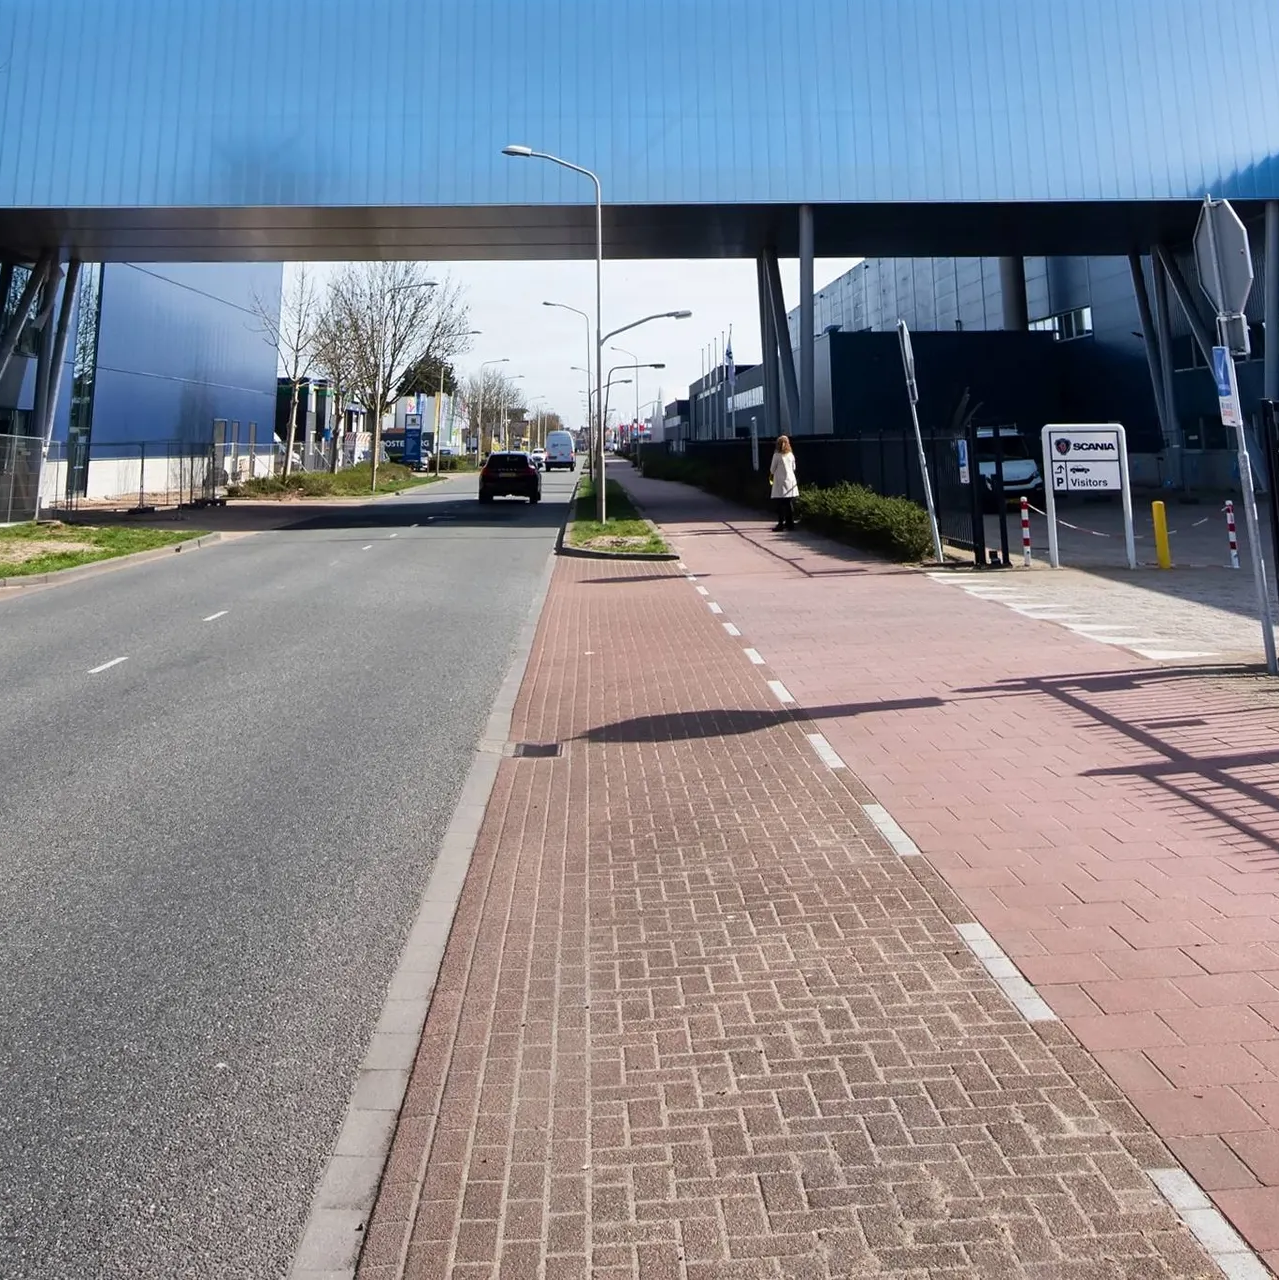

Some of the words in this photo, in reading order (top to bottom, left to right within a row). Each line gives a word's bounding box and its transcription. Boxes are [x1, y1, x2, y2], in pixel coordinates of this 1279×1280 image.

[1073, 442, 1115, 451] SCANIA
[1056, 477, 1064, 487] P
[1071, 478, 1109, 487] Visitors
